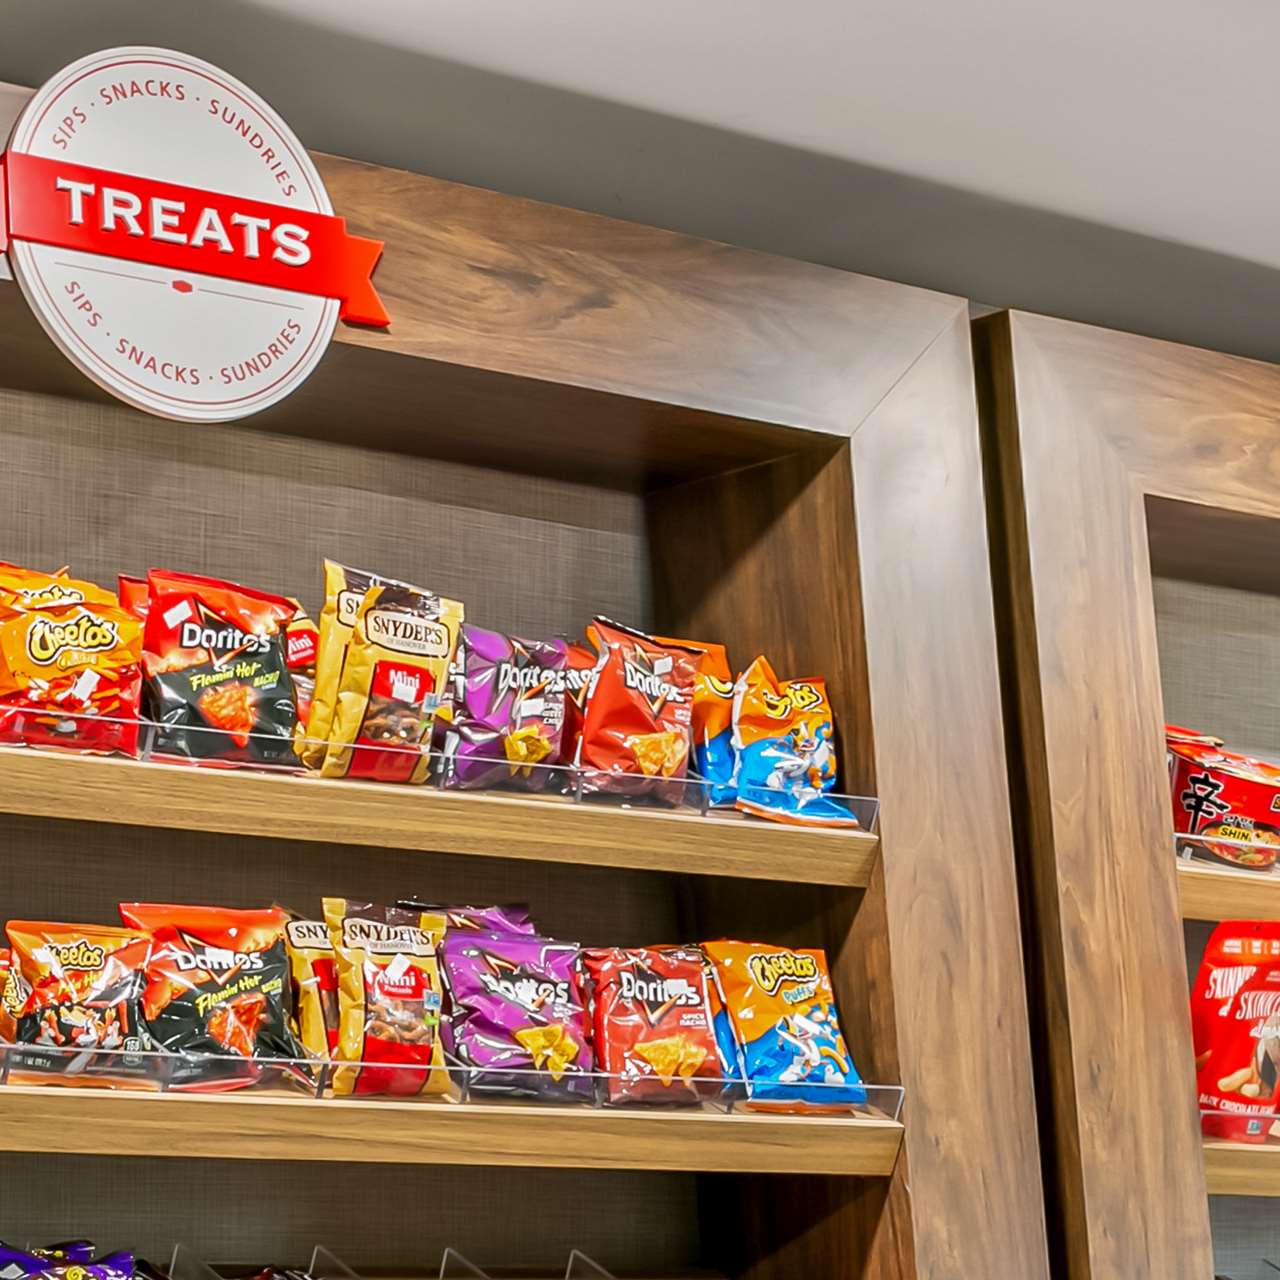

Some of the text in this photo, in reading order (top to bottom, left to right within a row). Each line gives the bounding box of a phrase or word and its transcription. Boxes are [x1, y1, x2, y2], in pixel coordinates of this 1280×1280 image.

[52, 79, 298, 198] SIPS SNACKS SUNDRIES
[55, 176, 312, 267] TREATS
[65, 281, 302, 386] SIPS SNACKS SUNDRIES
[29, 614, 117, 661] Cheetos
[182, 622, 272, 653] Doritos
[619, 970, 702, 1006] Dorios
[750, 952, 817, 993] Cheetos
